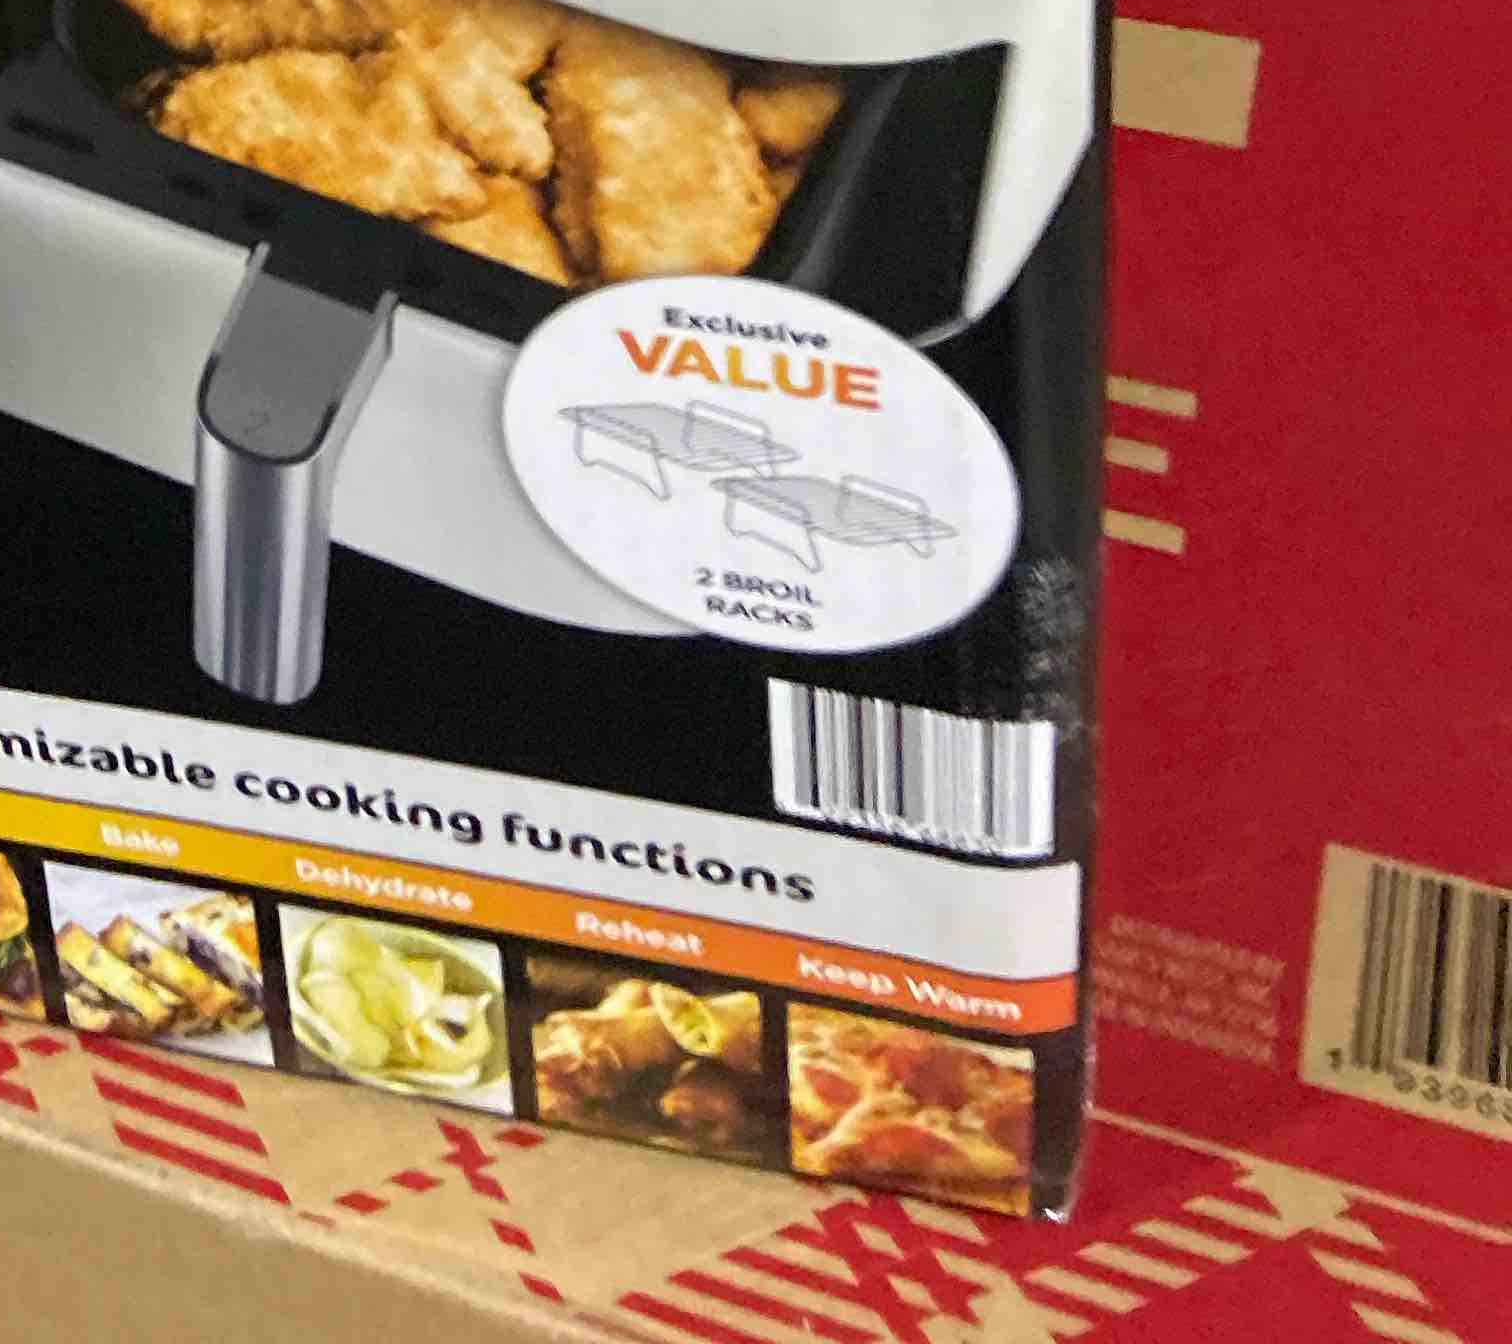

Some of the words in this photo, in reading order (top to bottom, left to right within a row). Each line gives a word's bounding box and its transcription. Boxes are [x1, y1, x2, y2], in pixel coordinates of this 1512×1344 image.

[662, 306, 831, 351] Exclusive
[617, 328, 883, 411] VALUE
[694, 568, 713, 588] 2
[722, 572, 822, 609] BROIL
[706, 596, 816, 633] RACKS
[99, 821, 181, 859] Bake
[234, 770, 484, 845] cooking
[502, 811, 816, 902] functions
[293, 857, 475, 914] Dehydrate
[575, 911, 705, 957] Reheat
[798, 951, 896, 998] Keep
[904, 975, 1023, 1022] Warm
